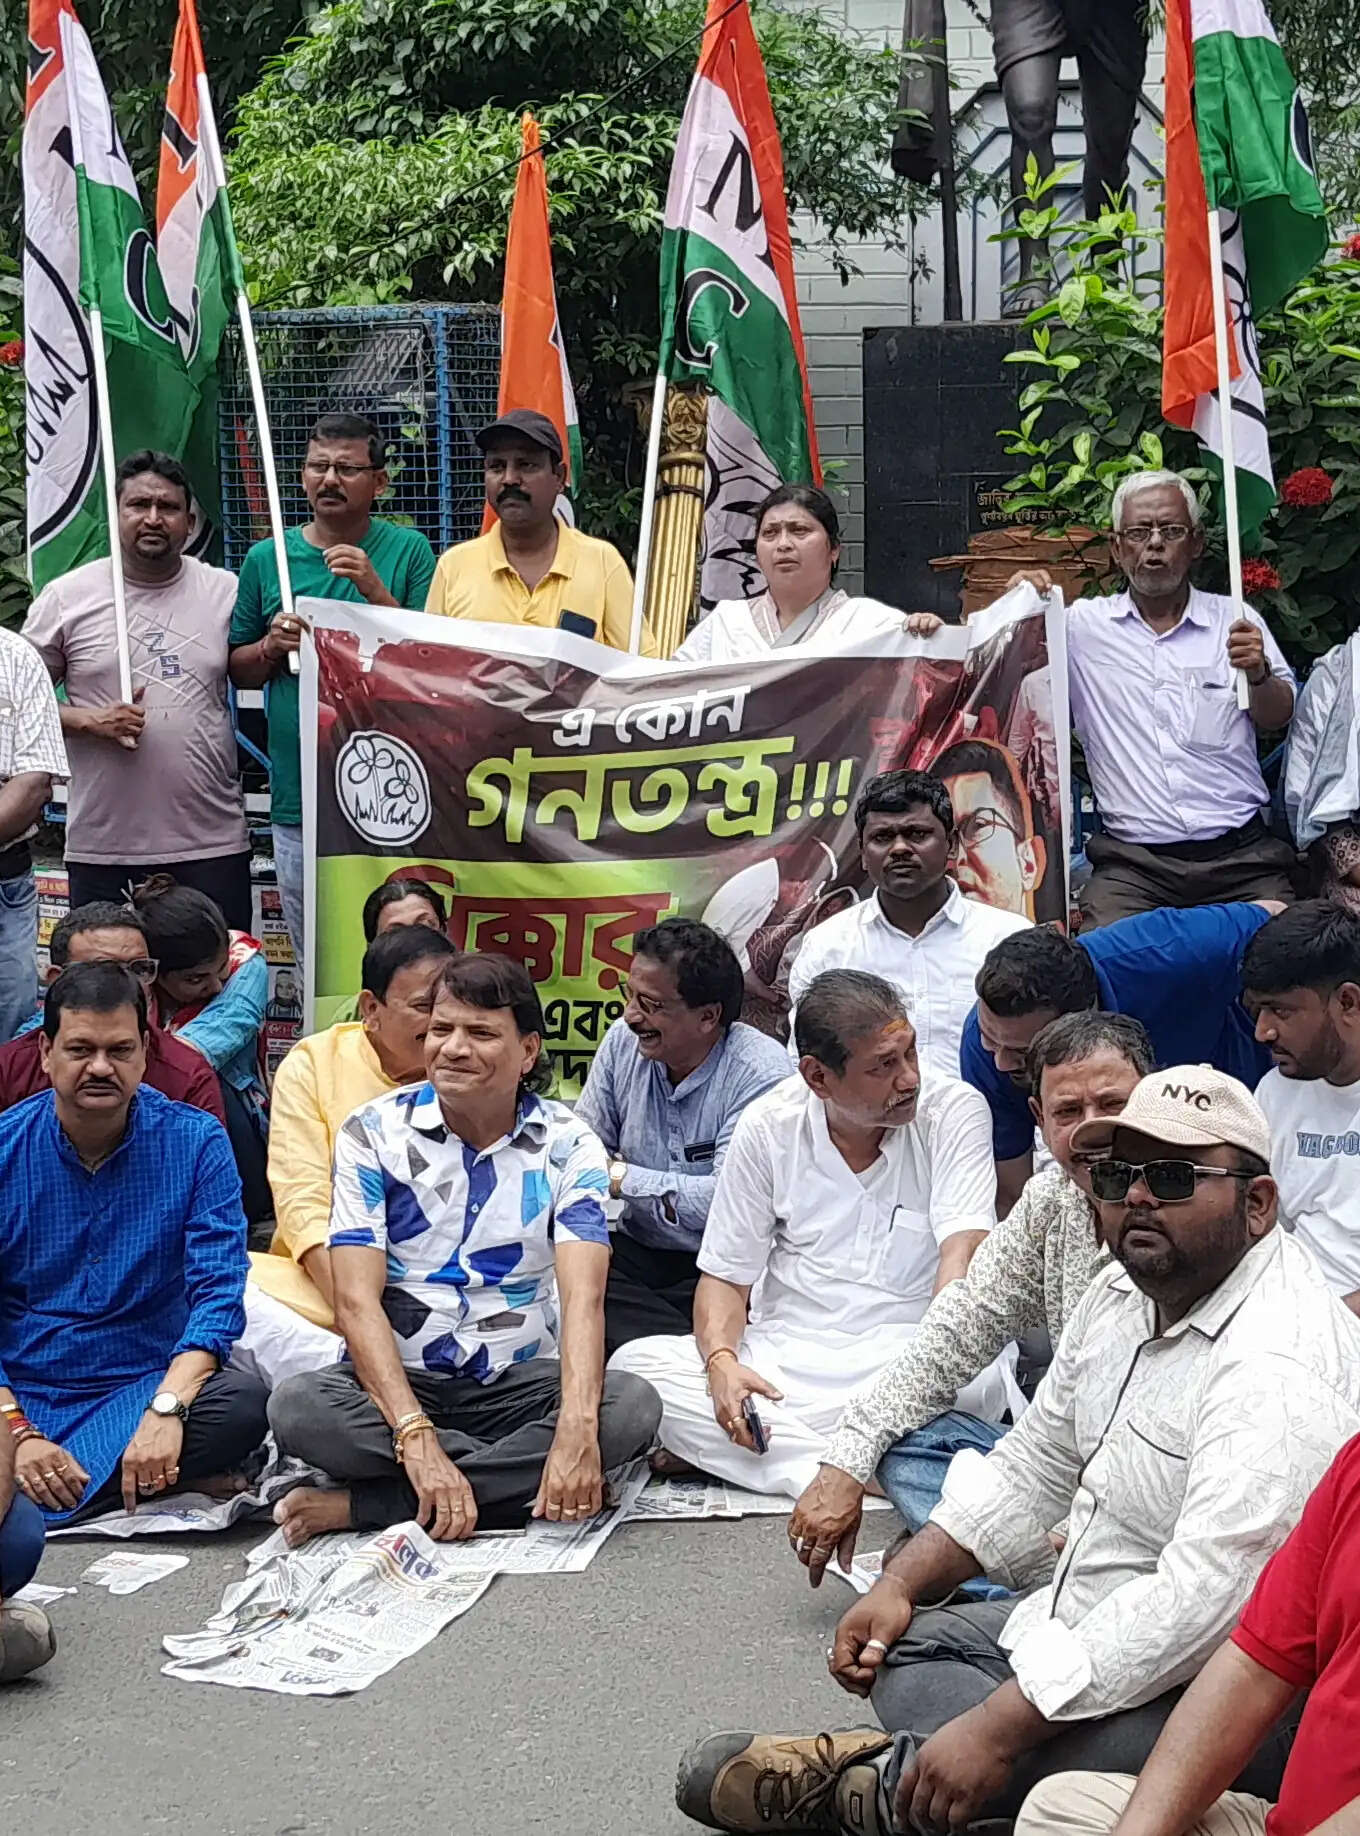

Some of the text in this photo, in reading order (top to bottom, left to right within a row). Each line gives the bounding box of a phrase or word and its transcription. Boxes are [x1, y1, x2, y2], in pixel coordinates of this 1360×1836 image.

[553, 685, 751, 748] এ কোন
[542, 998, 625, 1042] এবং
[1162, 1084, 1211, 1111] NYC
